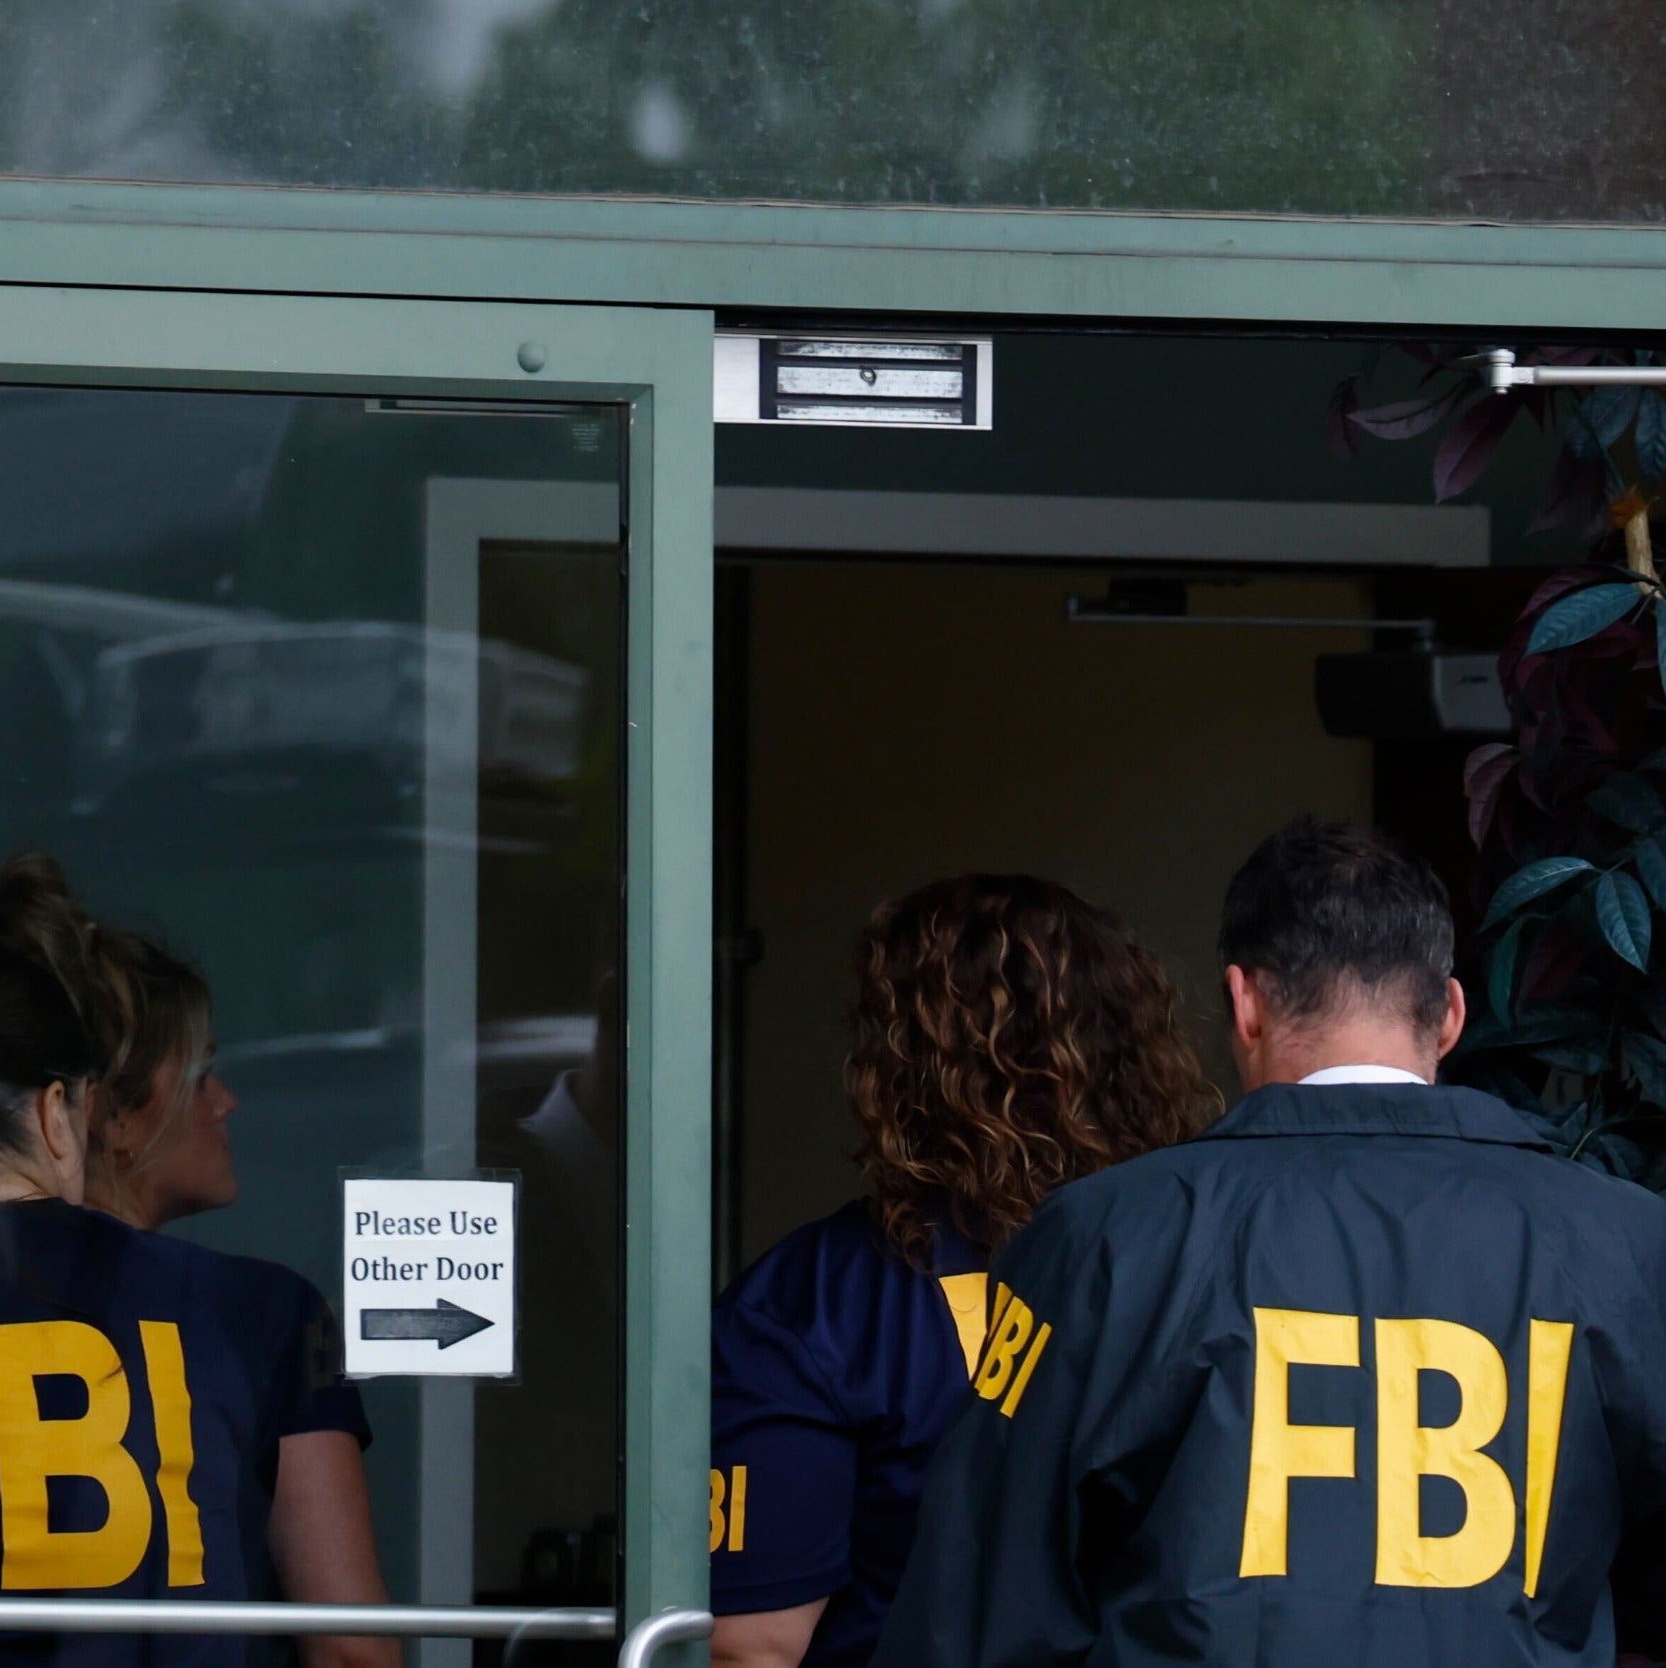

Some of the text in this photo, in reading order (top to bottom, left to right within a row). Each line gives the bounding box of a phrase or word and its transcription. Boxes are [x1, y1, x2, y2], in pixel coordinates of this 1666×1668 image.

[355, 1210, 498, 1235] Please Use
[351, 1257, 504, 1281] Other Door
[1240, 1306, 1574, 1599] FBI
